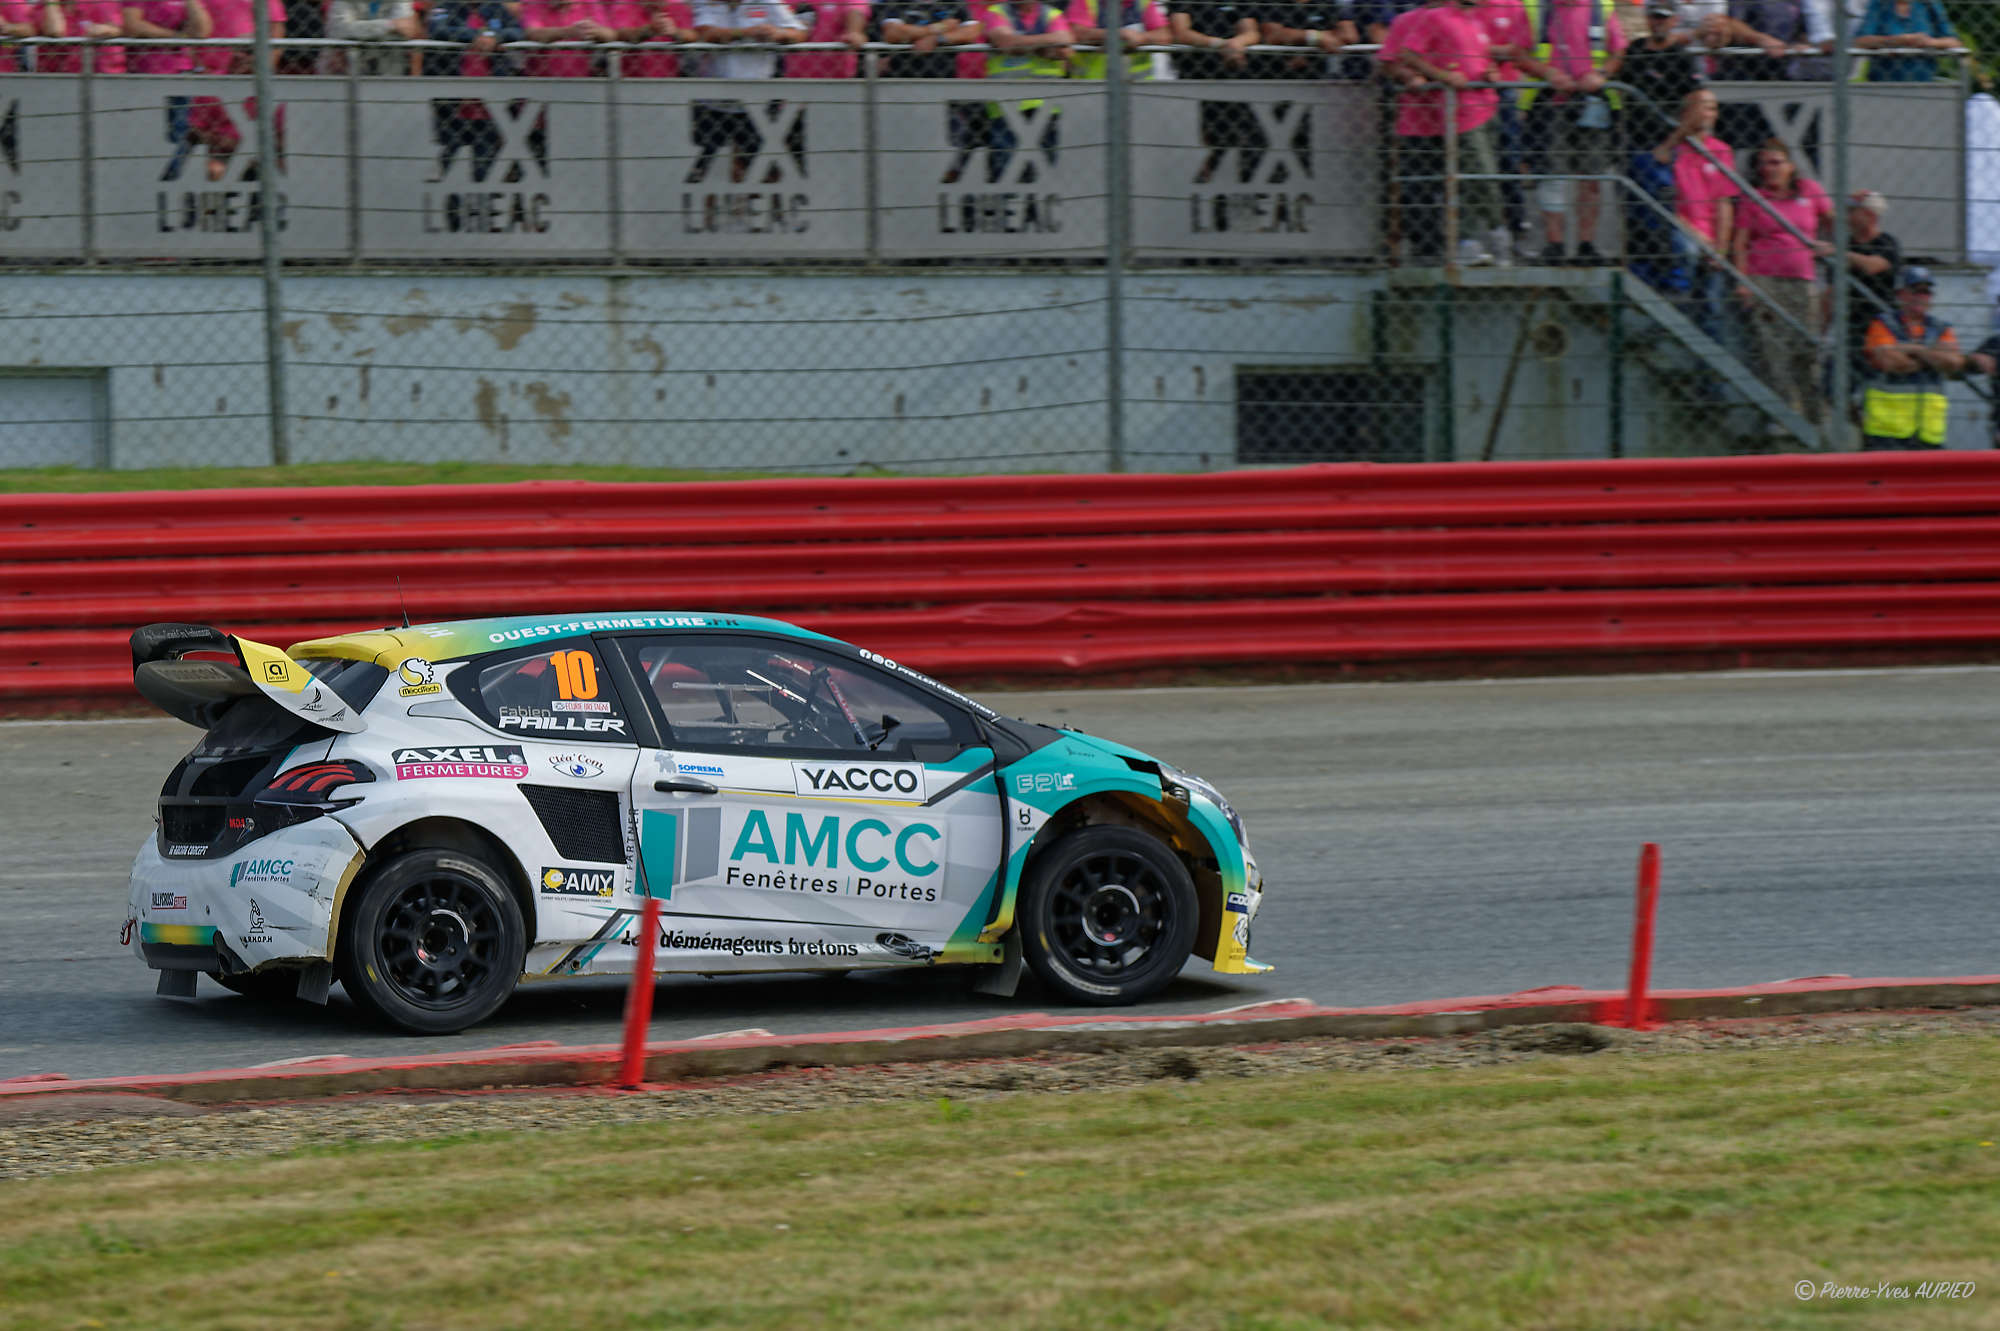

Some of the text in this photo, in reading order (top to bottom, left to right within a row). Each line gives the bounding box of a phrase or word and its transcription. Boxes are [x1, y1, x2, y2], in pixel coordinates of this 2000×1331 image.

[549, 650, 599, 700] 10
[499, 706, 551, 717] Fabien
[498, 717, 627, 736] PAILLER
[396, 748, 508, 764] AXEL
[402, 765, 524, 778] FERMETURES
[678, 764, 724, 773] SOPREMA
[801, 767, 918, 793] YACCO
[729, 809, 942, 877] AMCC
[246, 859, 294, 875] AMCC
[566, 872, 613, 892] AMY
[726, 867, 936, 902] Fenêtres Portes
[660, 930, 784, 957] déménageurs
[788, 938, 859, 957] bretons
